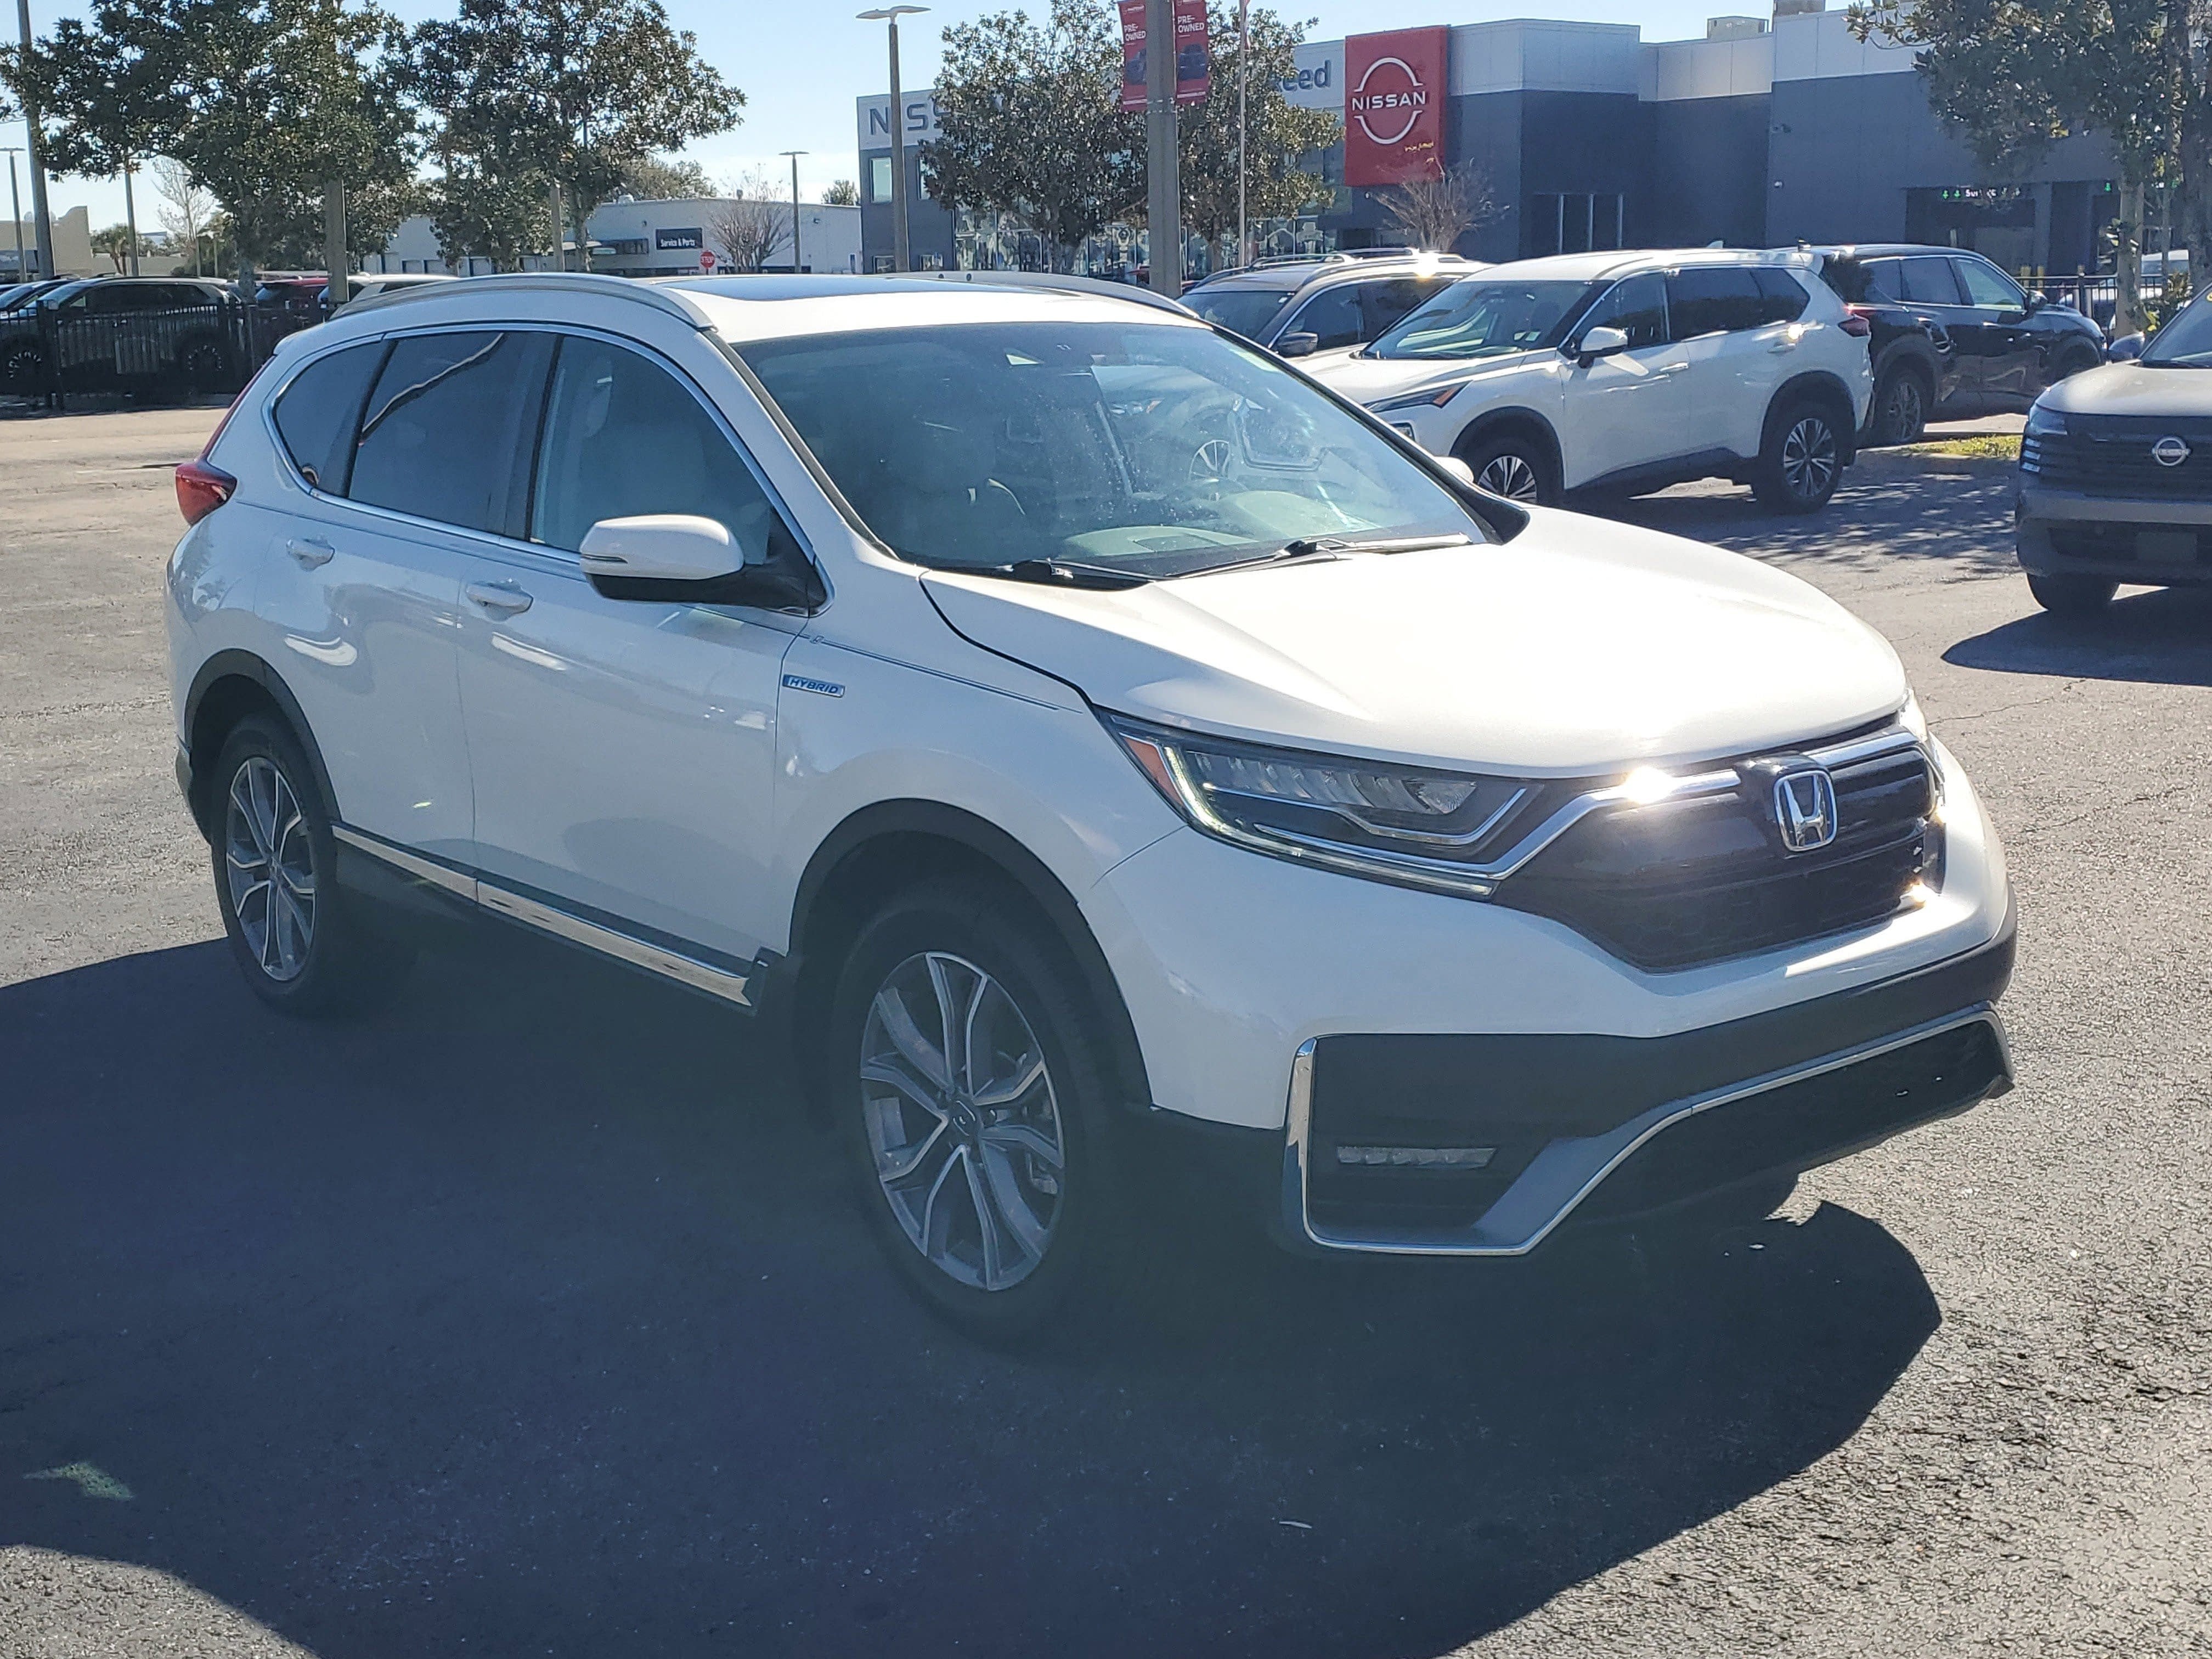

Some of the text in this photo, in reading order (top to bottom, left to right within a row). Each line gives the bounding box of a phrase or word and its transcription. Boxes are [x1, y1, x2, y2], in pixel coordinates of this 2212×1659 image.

[1178, 22, 1205, 33] OWNED
[1352, 91, 1426, 111] NISSAN
[789, 678, 839, 693] HYBRID
